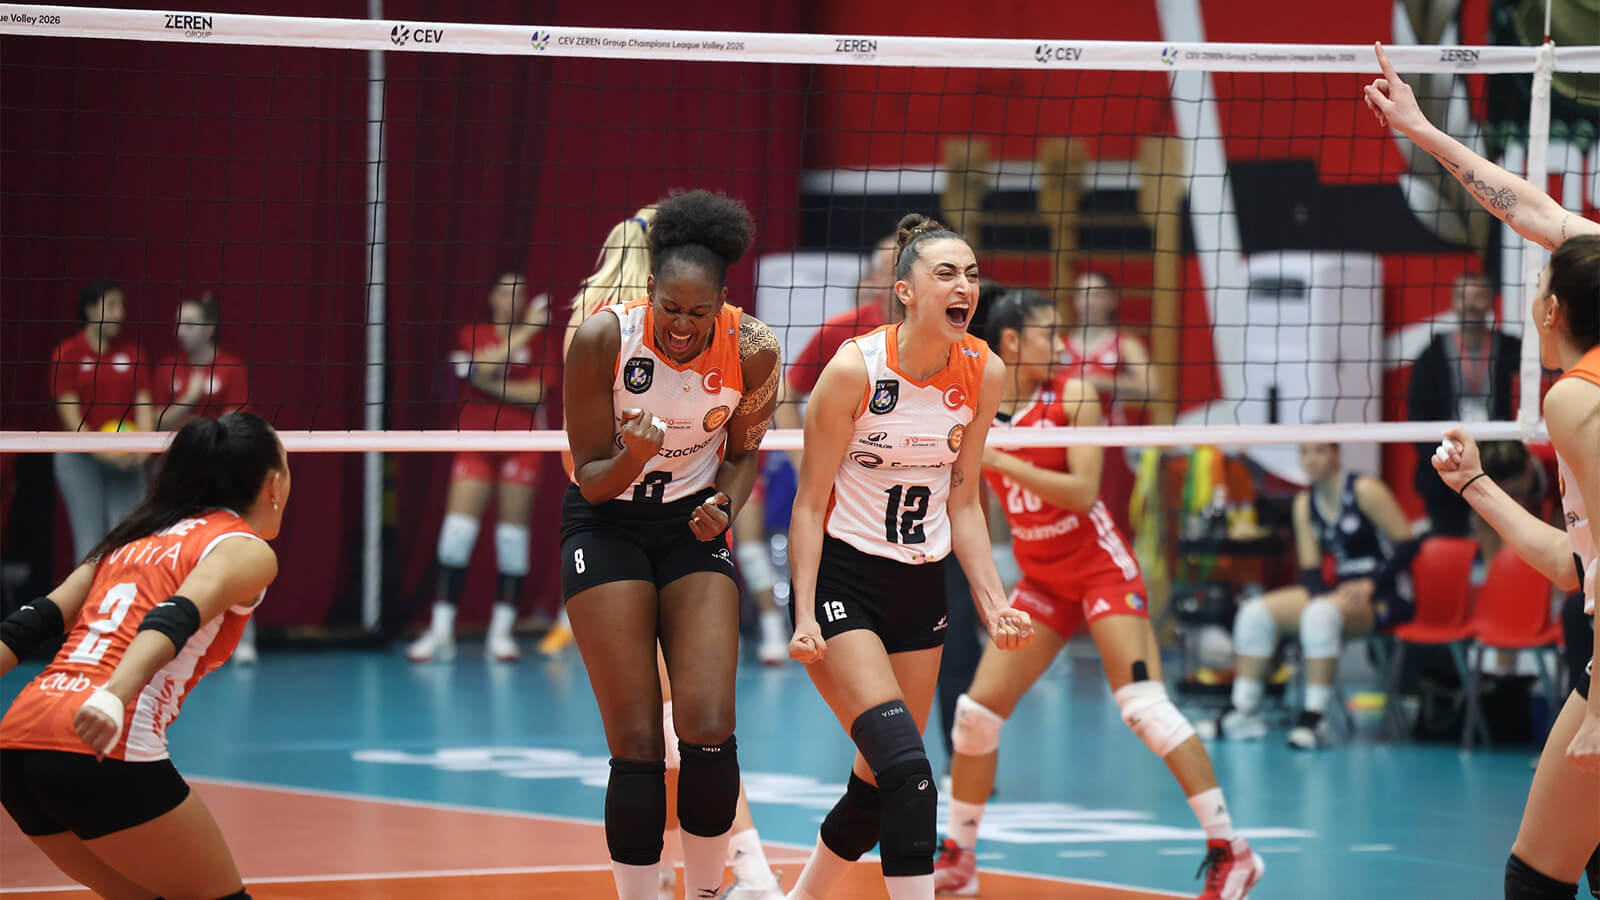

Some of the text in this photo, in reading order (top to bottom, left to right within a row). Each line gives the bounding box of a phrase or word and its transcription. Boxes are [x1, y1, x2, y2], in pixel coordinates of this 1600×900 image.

[10, 14, 37, 25] Volley
[38, 15, 61, 24] 2026
[165, 14, 213, 29] ZEREN
[413, 29, 443, 43] CEV
[558, 36, 745, 51] CEV ZEREN Group Champions League Volley 2026
[835, 39, 877, 52] ZEREN
[1055, 47, 1082, 61] CEV
[1440, 49, 1480, 61] ZEREN
[885, 484, 931, 544] 12
[574, 548, 586, 574] 8
[823, 601, 847, 622] 12
[64, 582, 138, 665] 2
